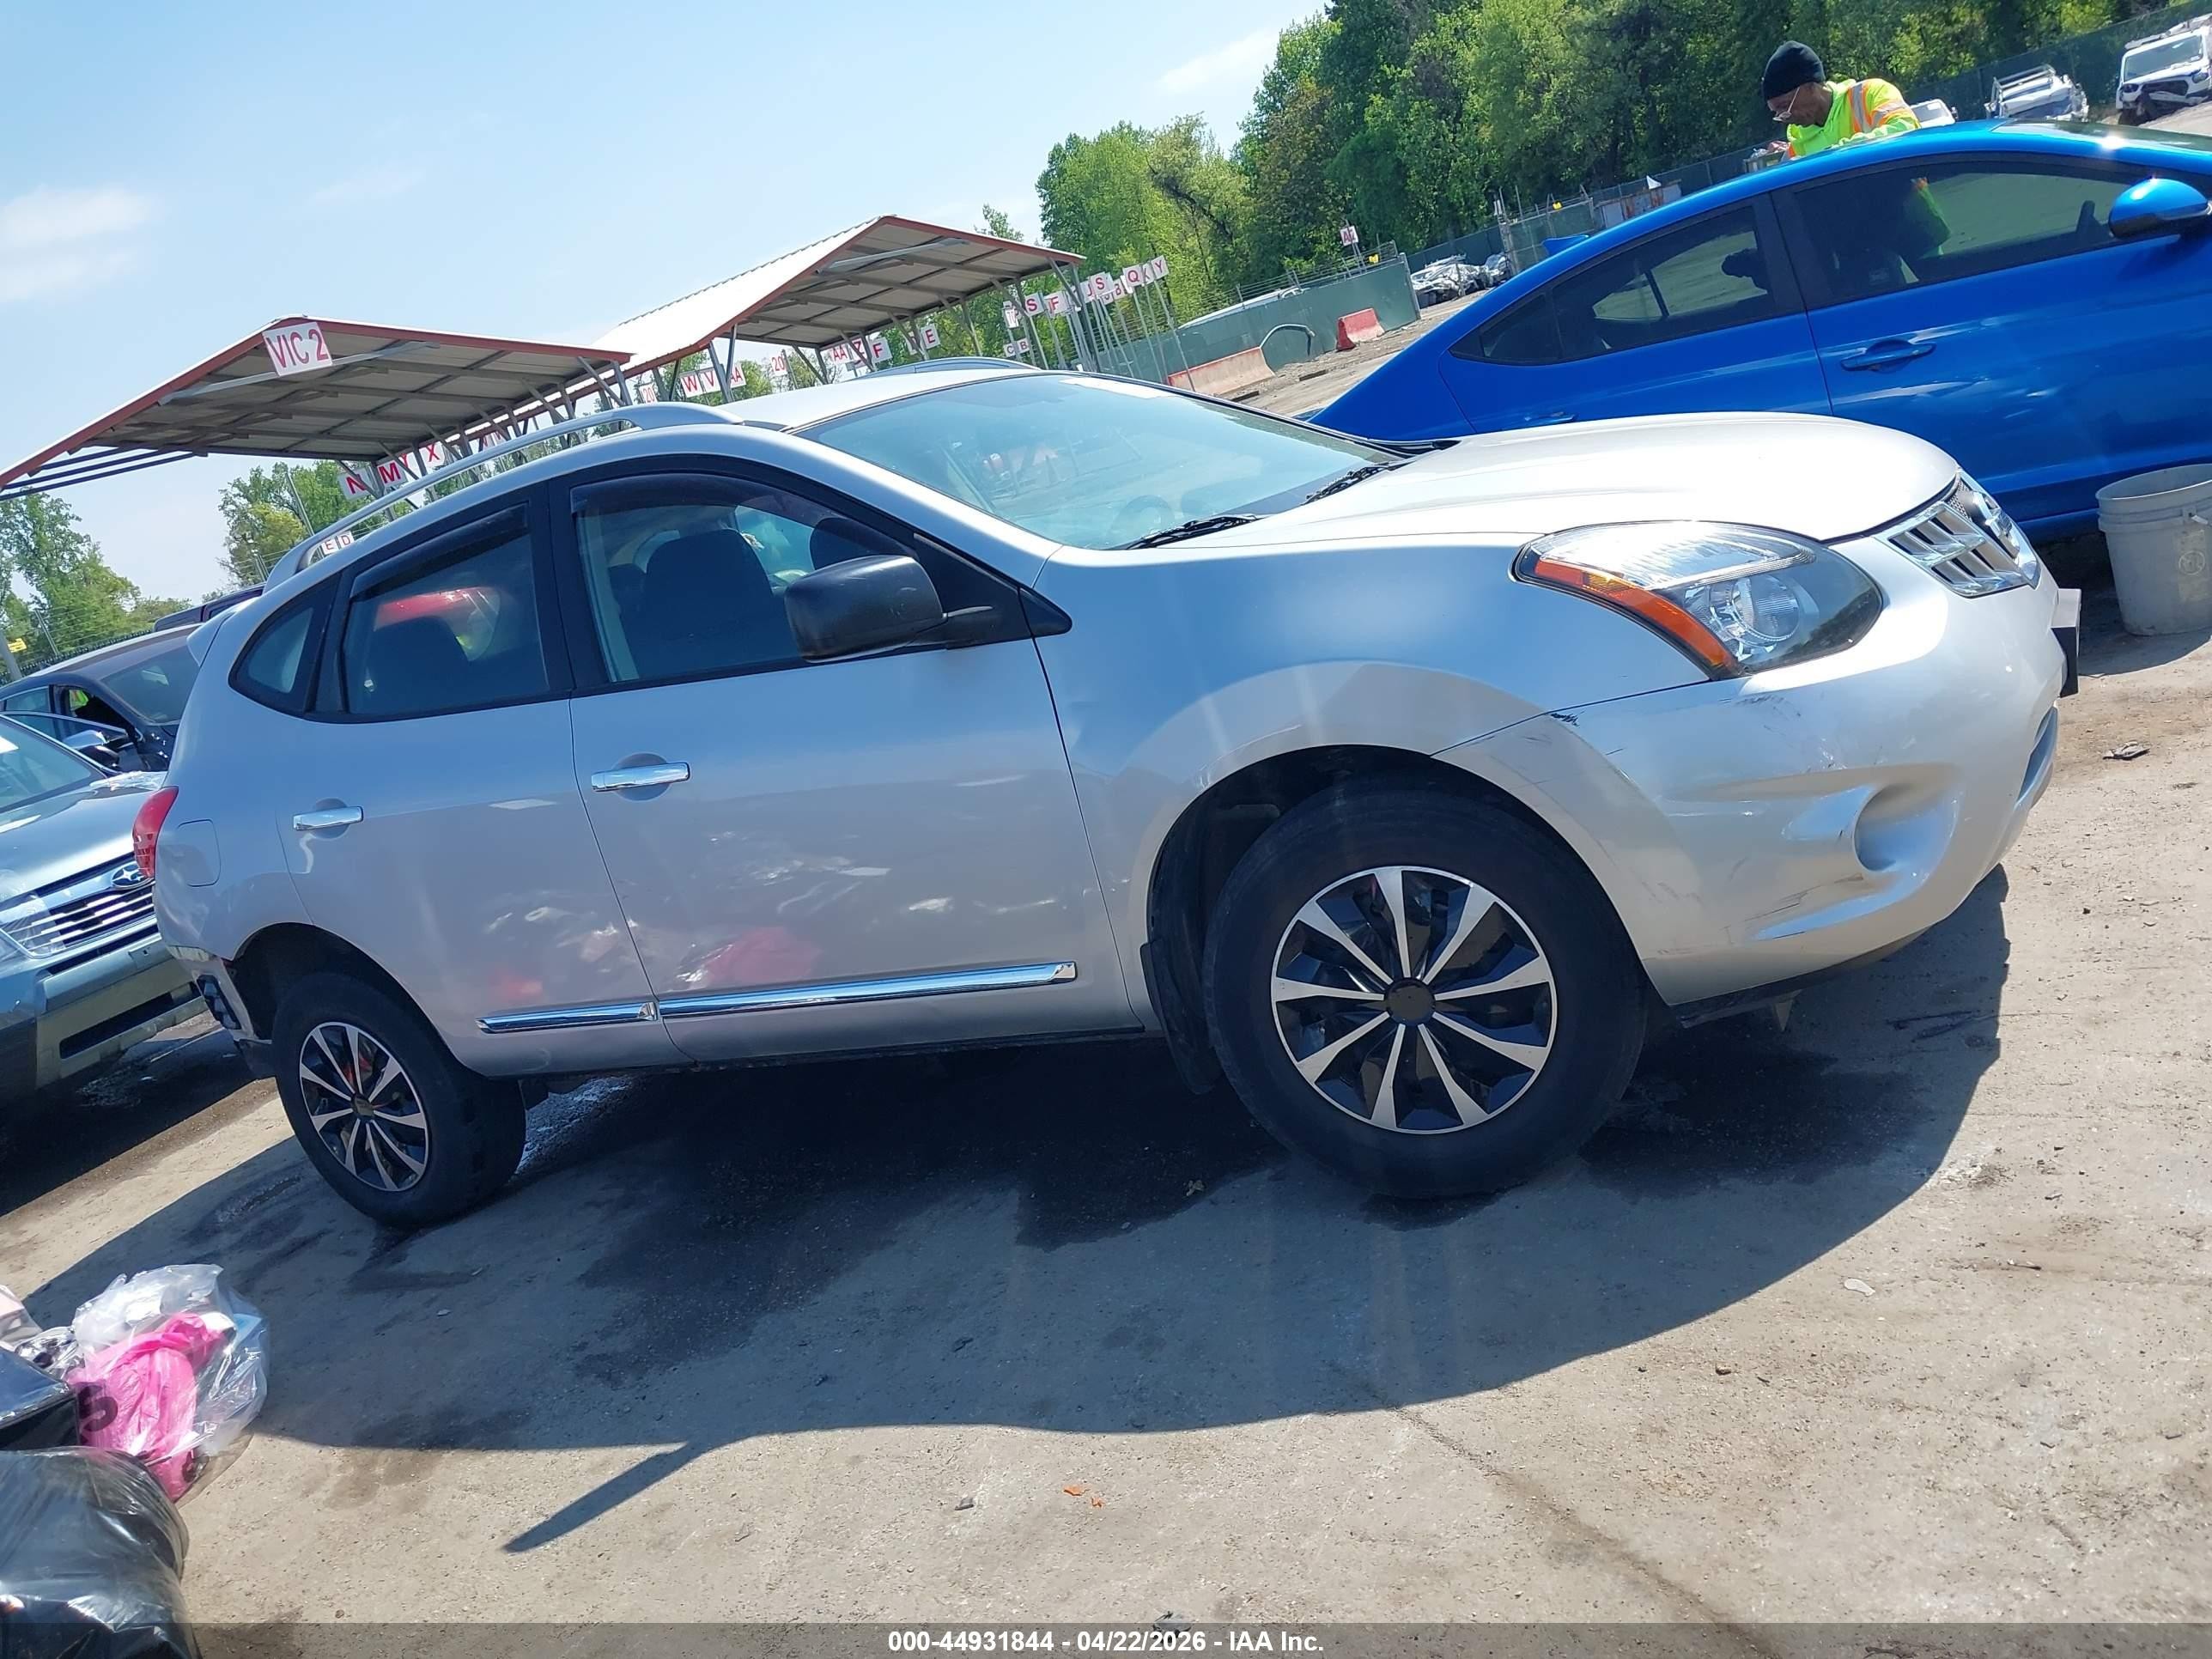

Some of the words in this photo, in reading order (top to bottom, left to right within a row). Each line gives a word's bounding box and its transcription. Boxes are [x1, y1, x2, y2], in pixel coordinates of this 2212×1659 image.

[1155, 259, 1164, 274] Y
[1095, 276, 1105, 290] S
[1127, 270, 1140, 283] Q
[1026, 298, 1038, 312] S
[1050, 295, 1060, 311] F
[925, 328, 936, 344] E
[265, 331, 310, 368] VIC
[308, 328, 330, 362] 2
[833, 344, 848, 362] AA
[872, 342, 883, 358] F
[771, 356, 786, 372] 20
[682, 374, 698, 392] W
[703, 370, 715, 387] V
[426, 443, 441, 463] X
[378, 461, 402, 484] M
[341, 534, 351, 546] D
